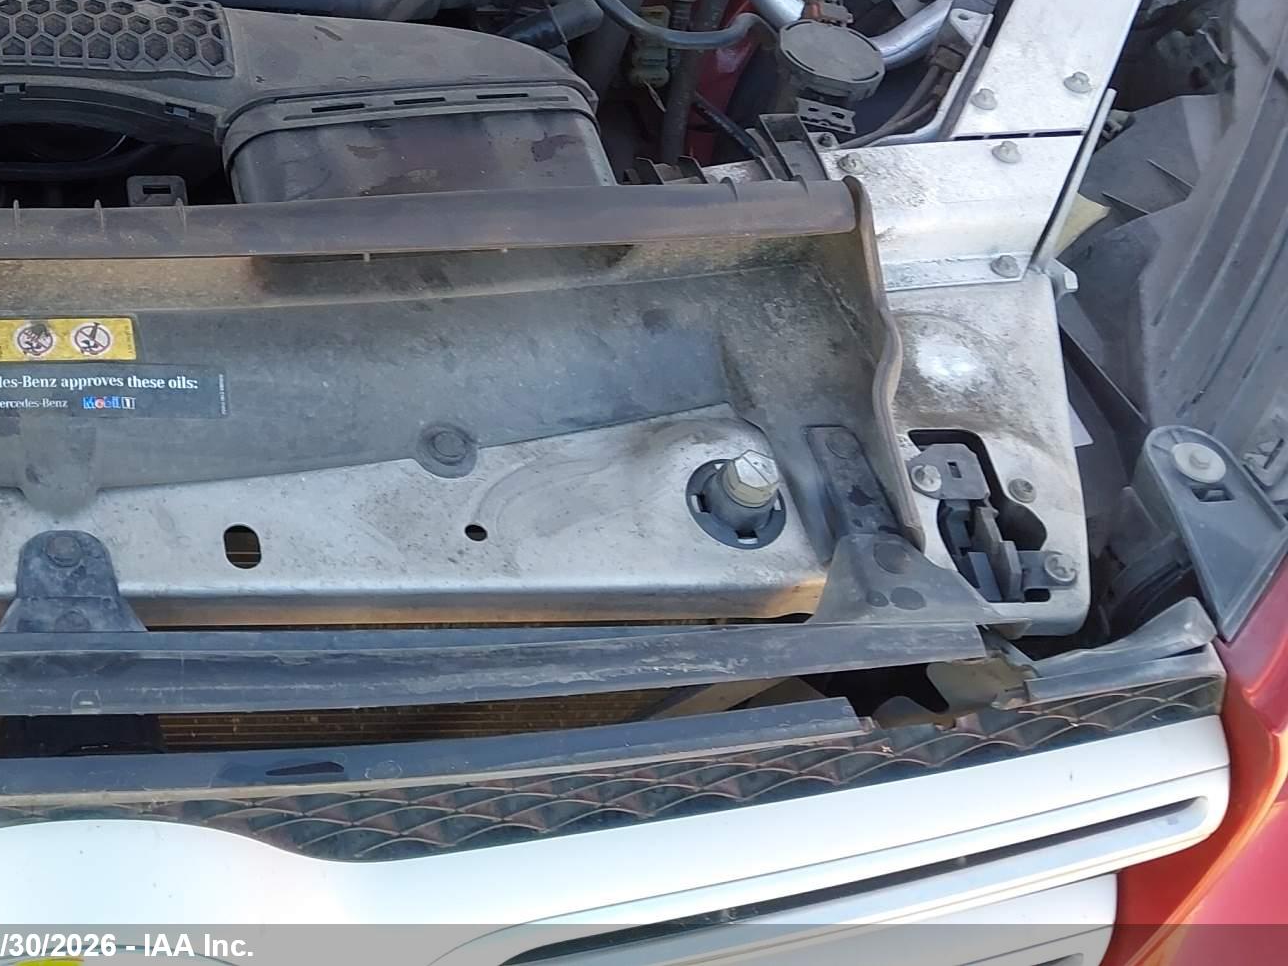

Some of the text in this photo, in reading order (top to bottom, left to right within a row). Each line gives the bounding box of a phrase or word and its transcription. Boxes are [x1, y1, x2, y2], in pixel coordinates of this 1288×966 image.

[60, 375, 124, 390] approves
[127, 374, 165, 389] these
[167, 375, 199, 390] oils:
